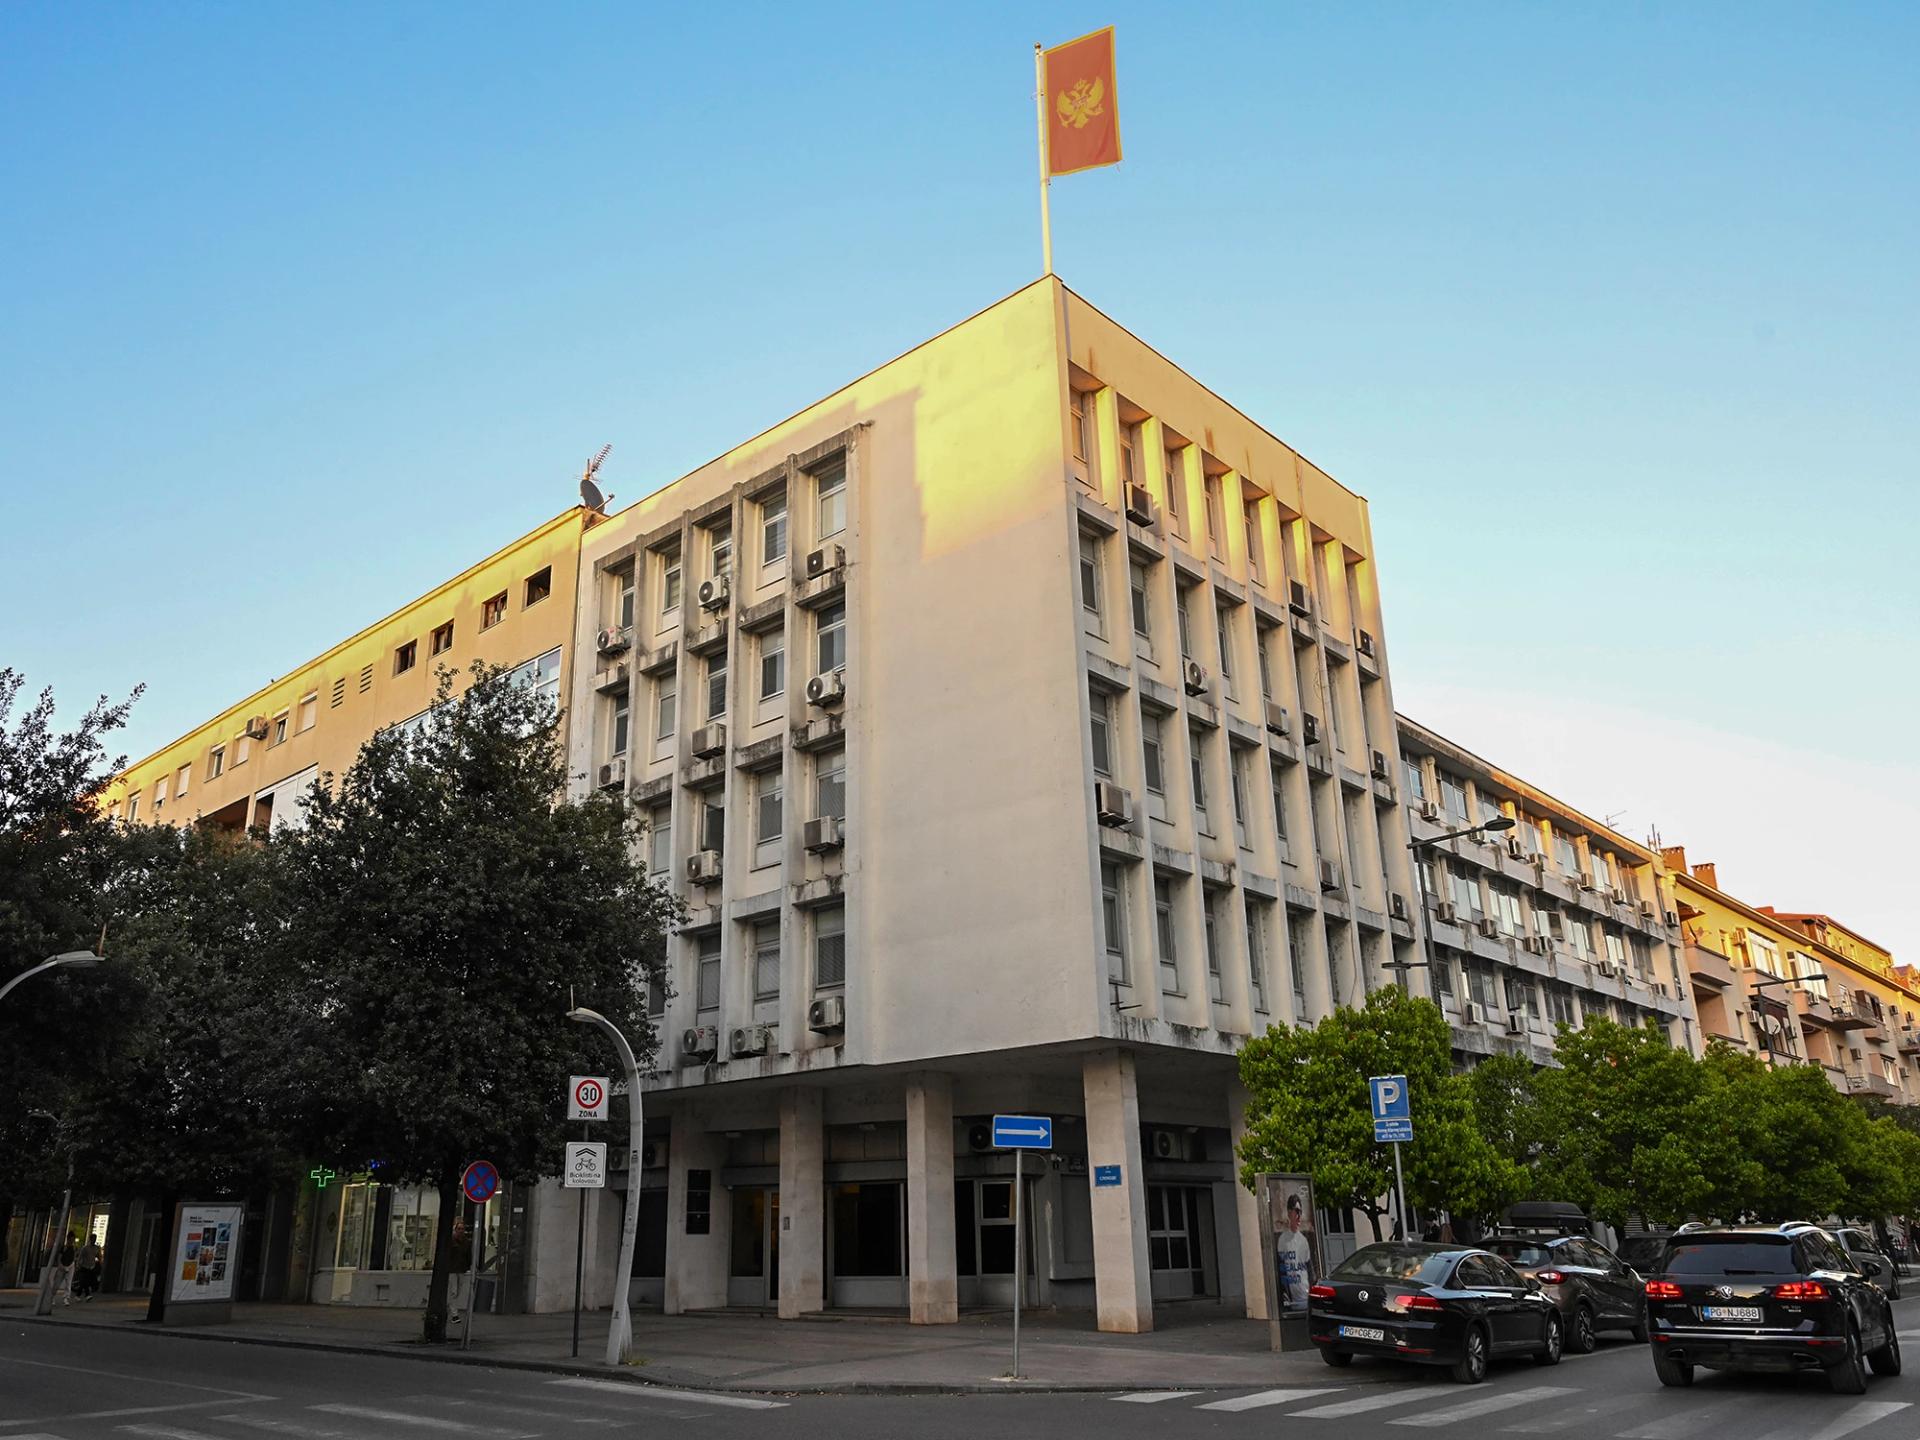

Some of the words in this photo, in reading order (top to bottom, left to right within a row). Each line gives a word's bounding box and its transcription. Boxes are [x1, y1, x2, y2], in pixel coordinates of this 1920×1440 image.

[582, 1088, 597, 1101] 30
[1377, 1081, 1400, 1115] P
[1710, 1308, 1722, 1316] PG
[1727, 1308, 1757, 1317] NJ688
[1344, 1326, 1354, 1336] PG
